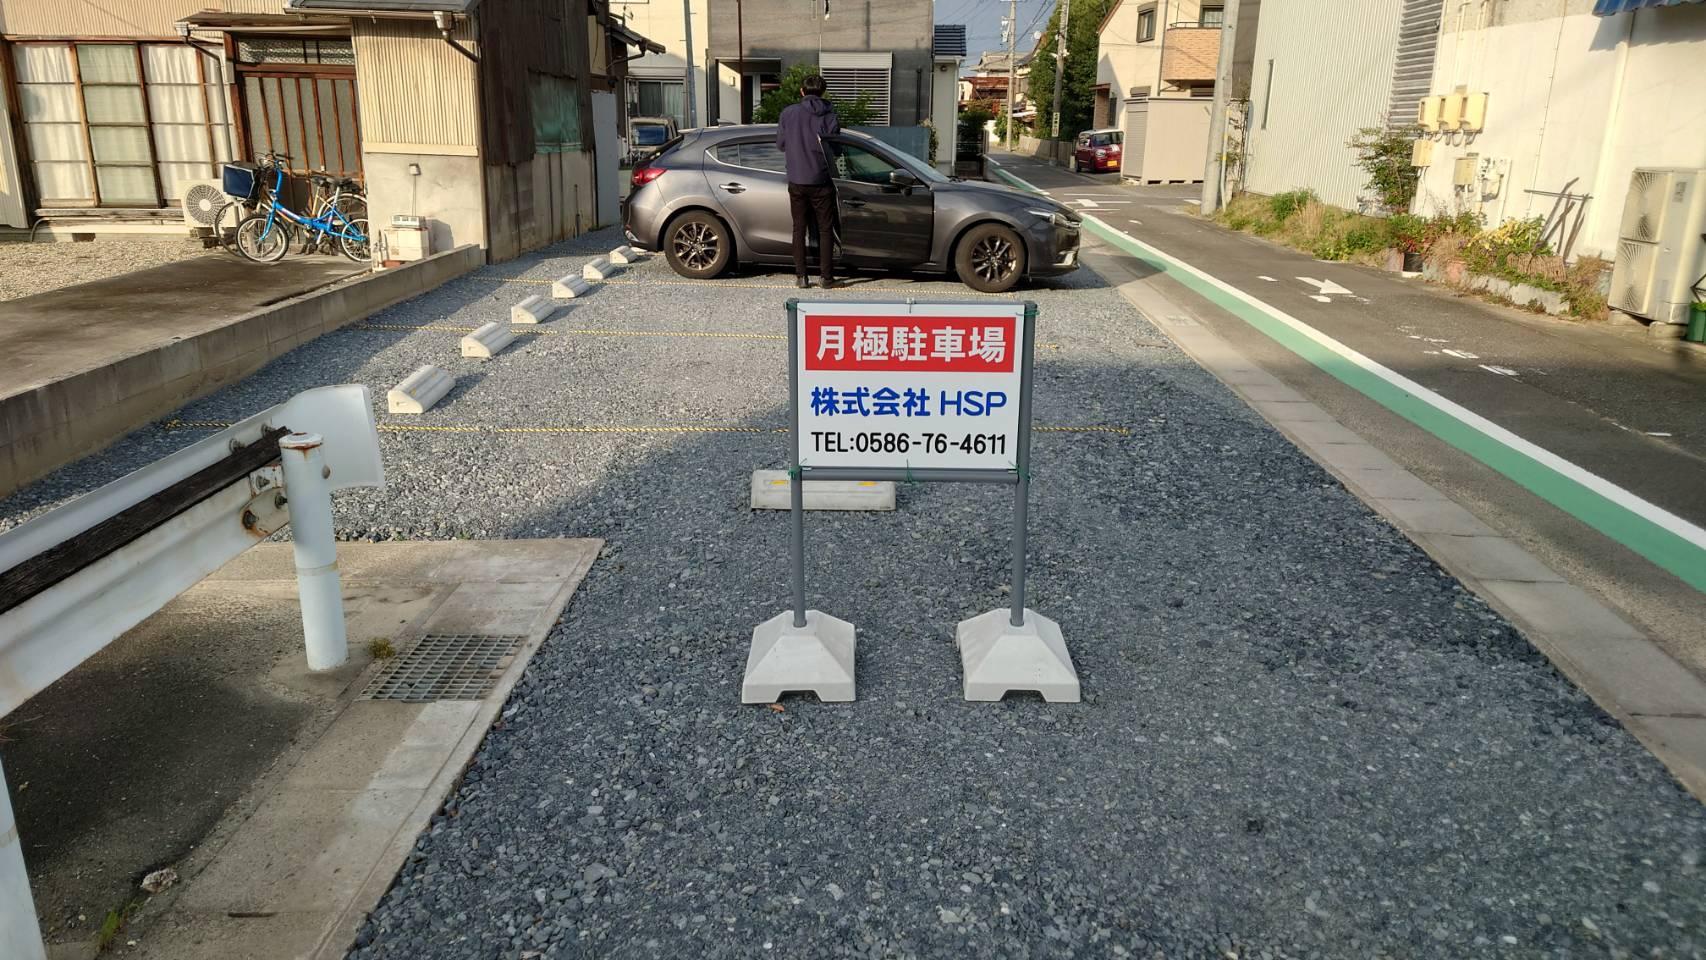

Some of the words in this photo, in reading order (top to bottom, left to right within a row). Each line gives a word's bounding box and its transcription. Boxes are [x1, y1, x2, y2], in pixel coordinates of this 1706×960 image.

[816, 325, 1006, 363] 月極駐車場
[811, 386, 931, 417] 株式会社
[940, 390, 1007, 417] HSP
[811, 431, 1006, 455] TEL:0586-76-4611
